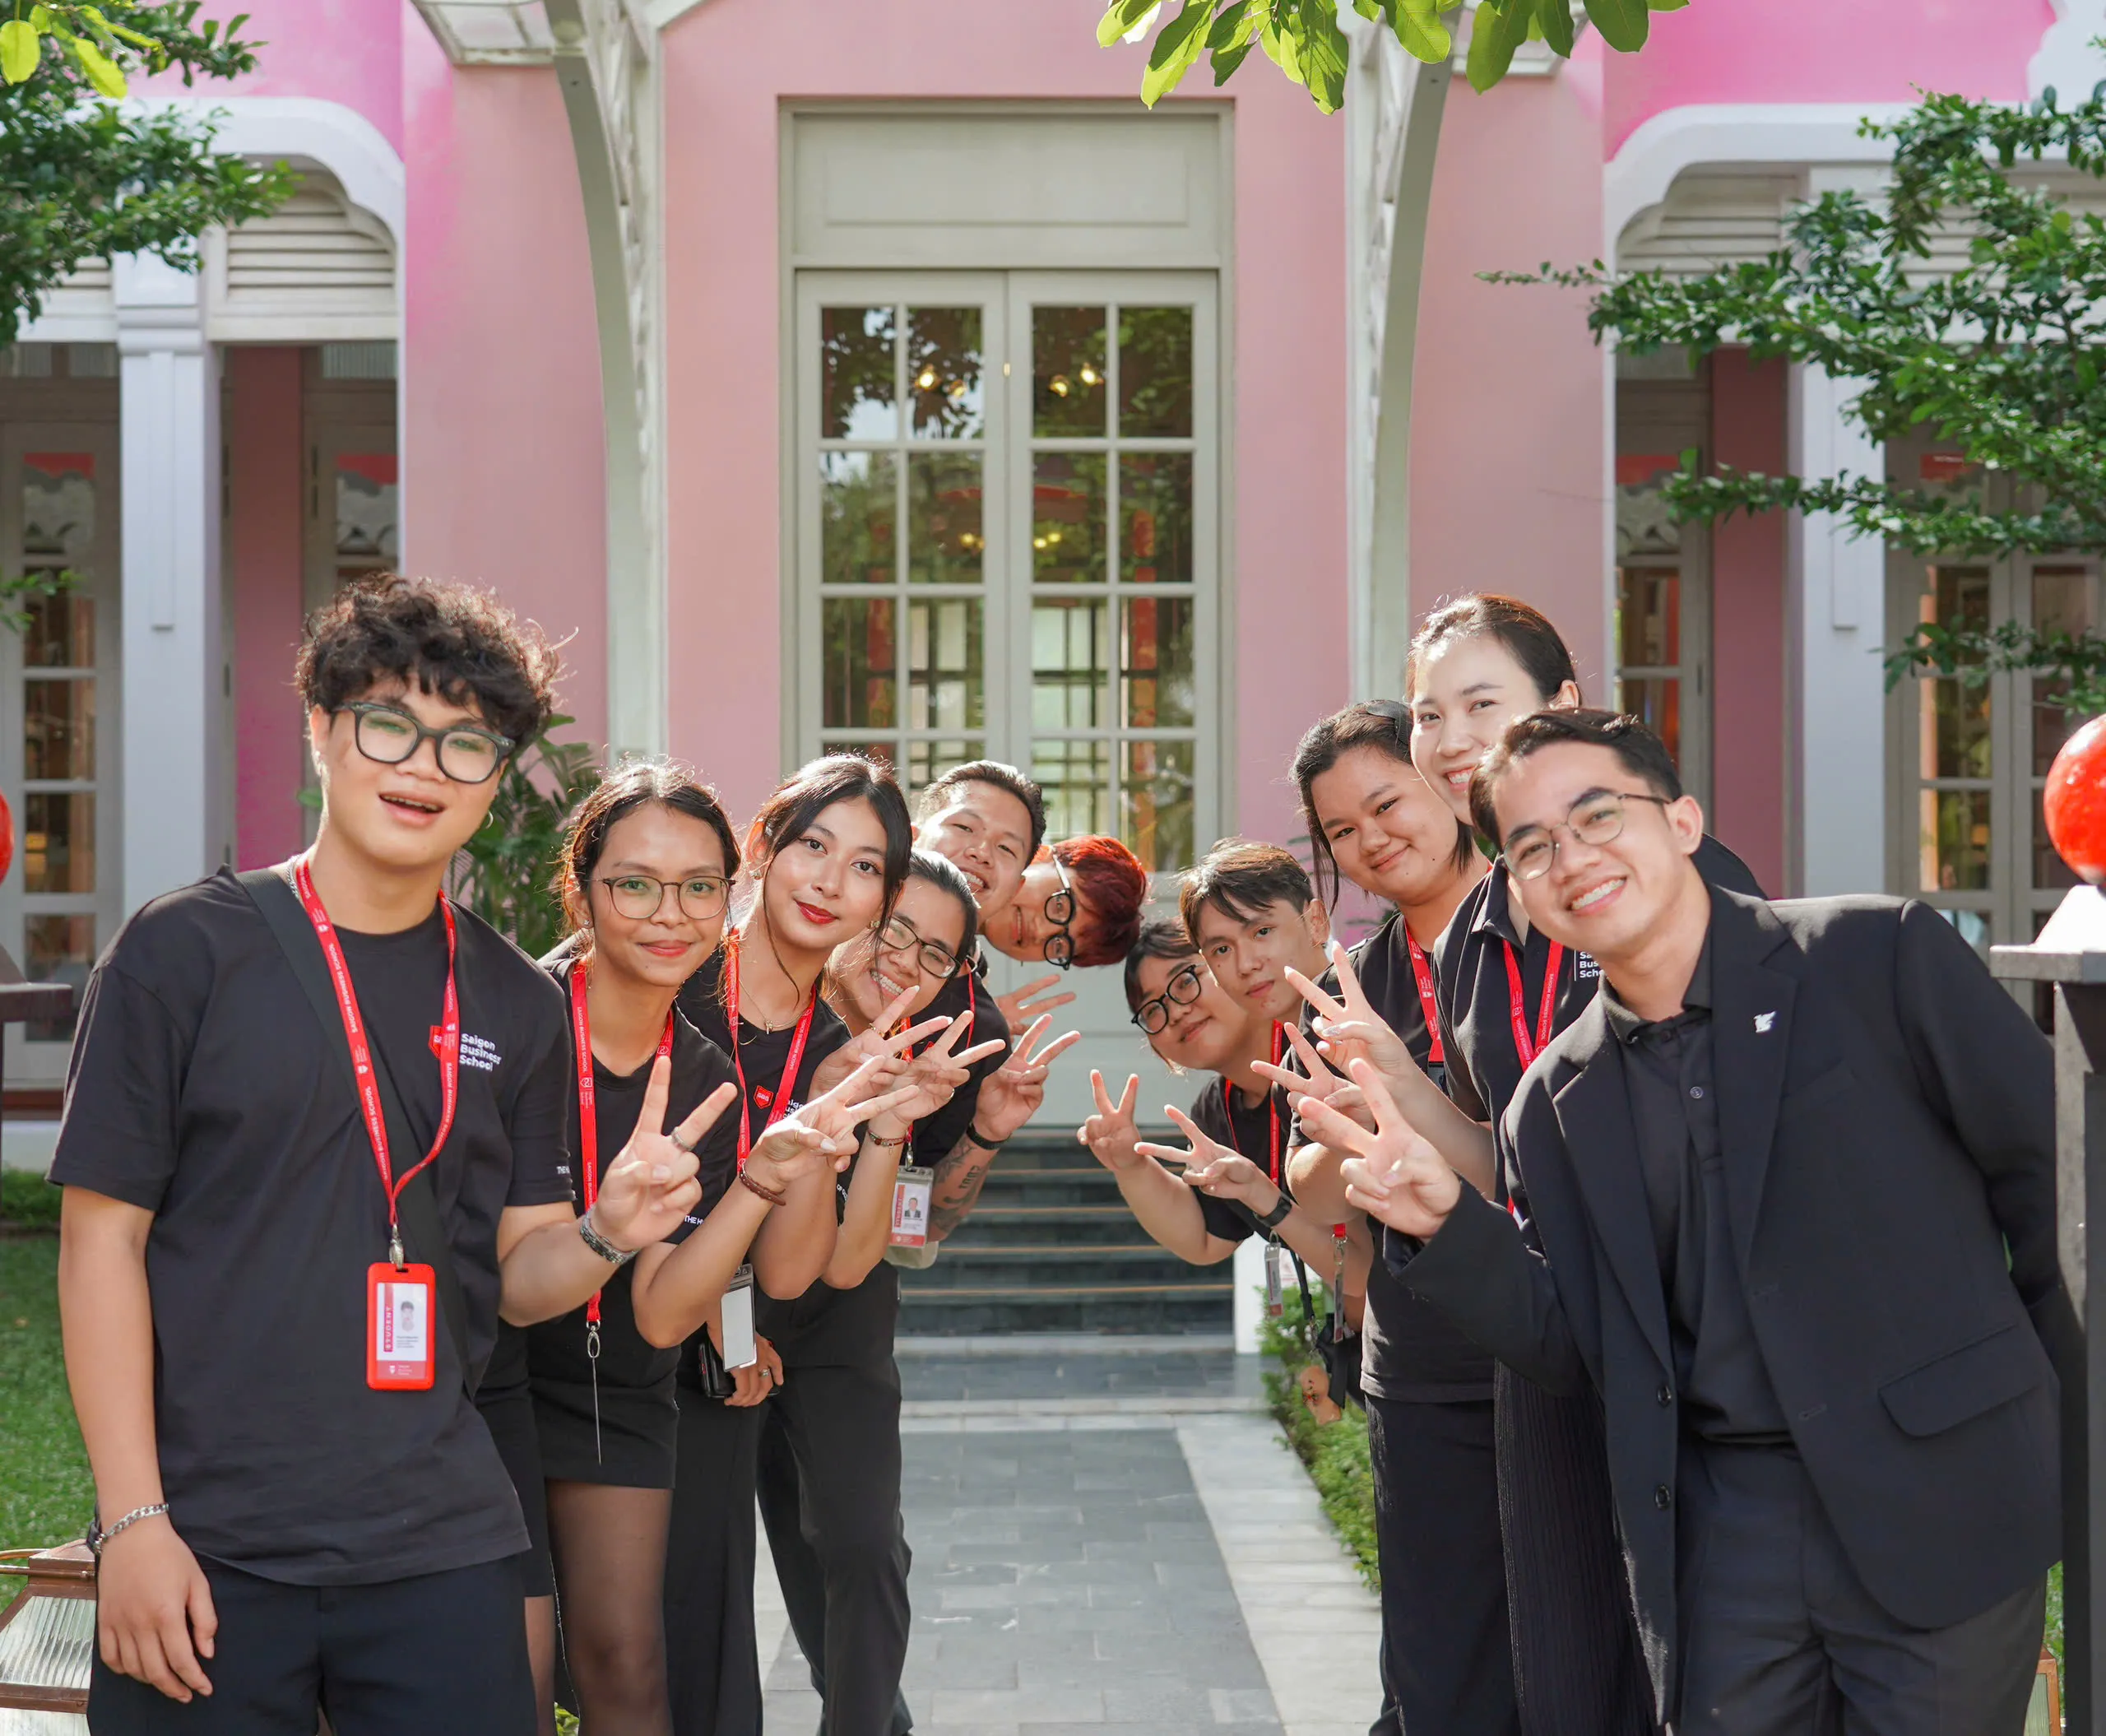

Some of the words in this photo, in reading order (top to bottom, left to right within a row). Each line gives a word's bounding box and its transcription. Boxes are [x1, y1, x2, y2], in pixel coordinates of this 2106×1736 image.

[461, 1033, 495, 1051] Saigon
[459, 1055, 494, 1072] School
[460, 1044, 502, 1065] Business
[365, 1086, 376, 1116] SCHOOL
[369, 1116, 384, 1152] BUSINESS
[684, 1214, 697, 1224] THE
